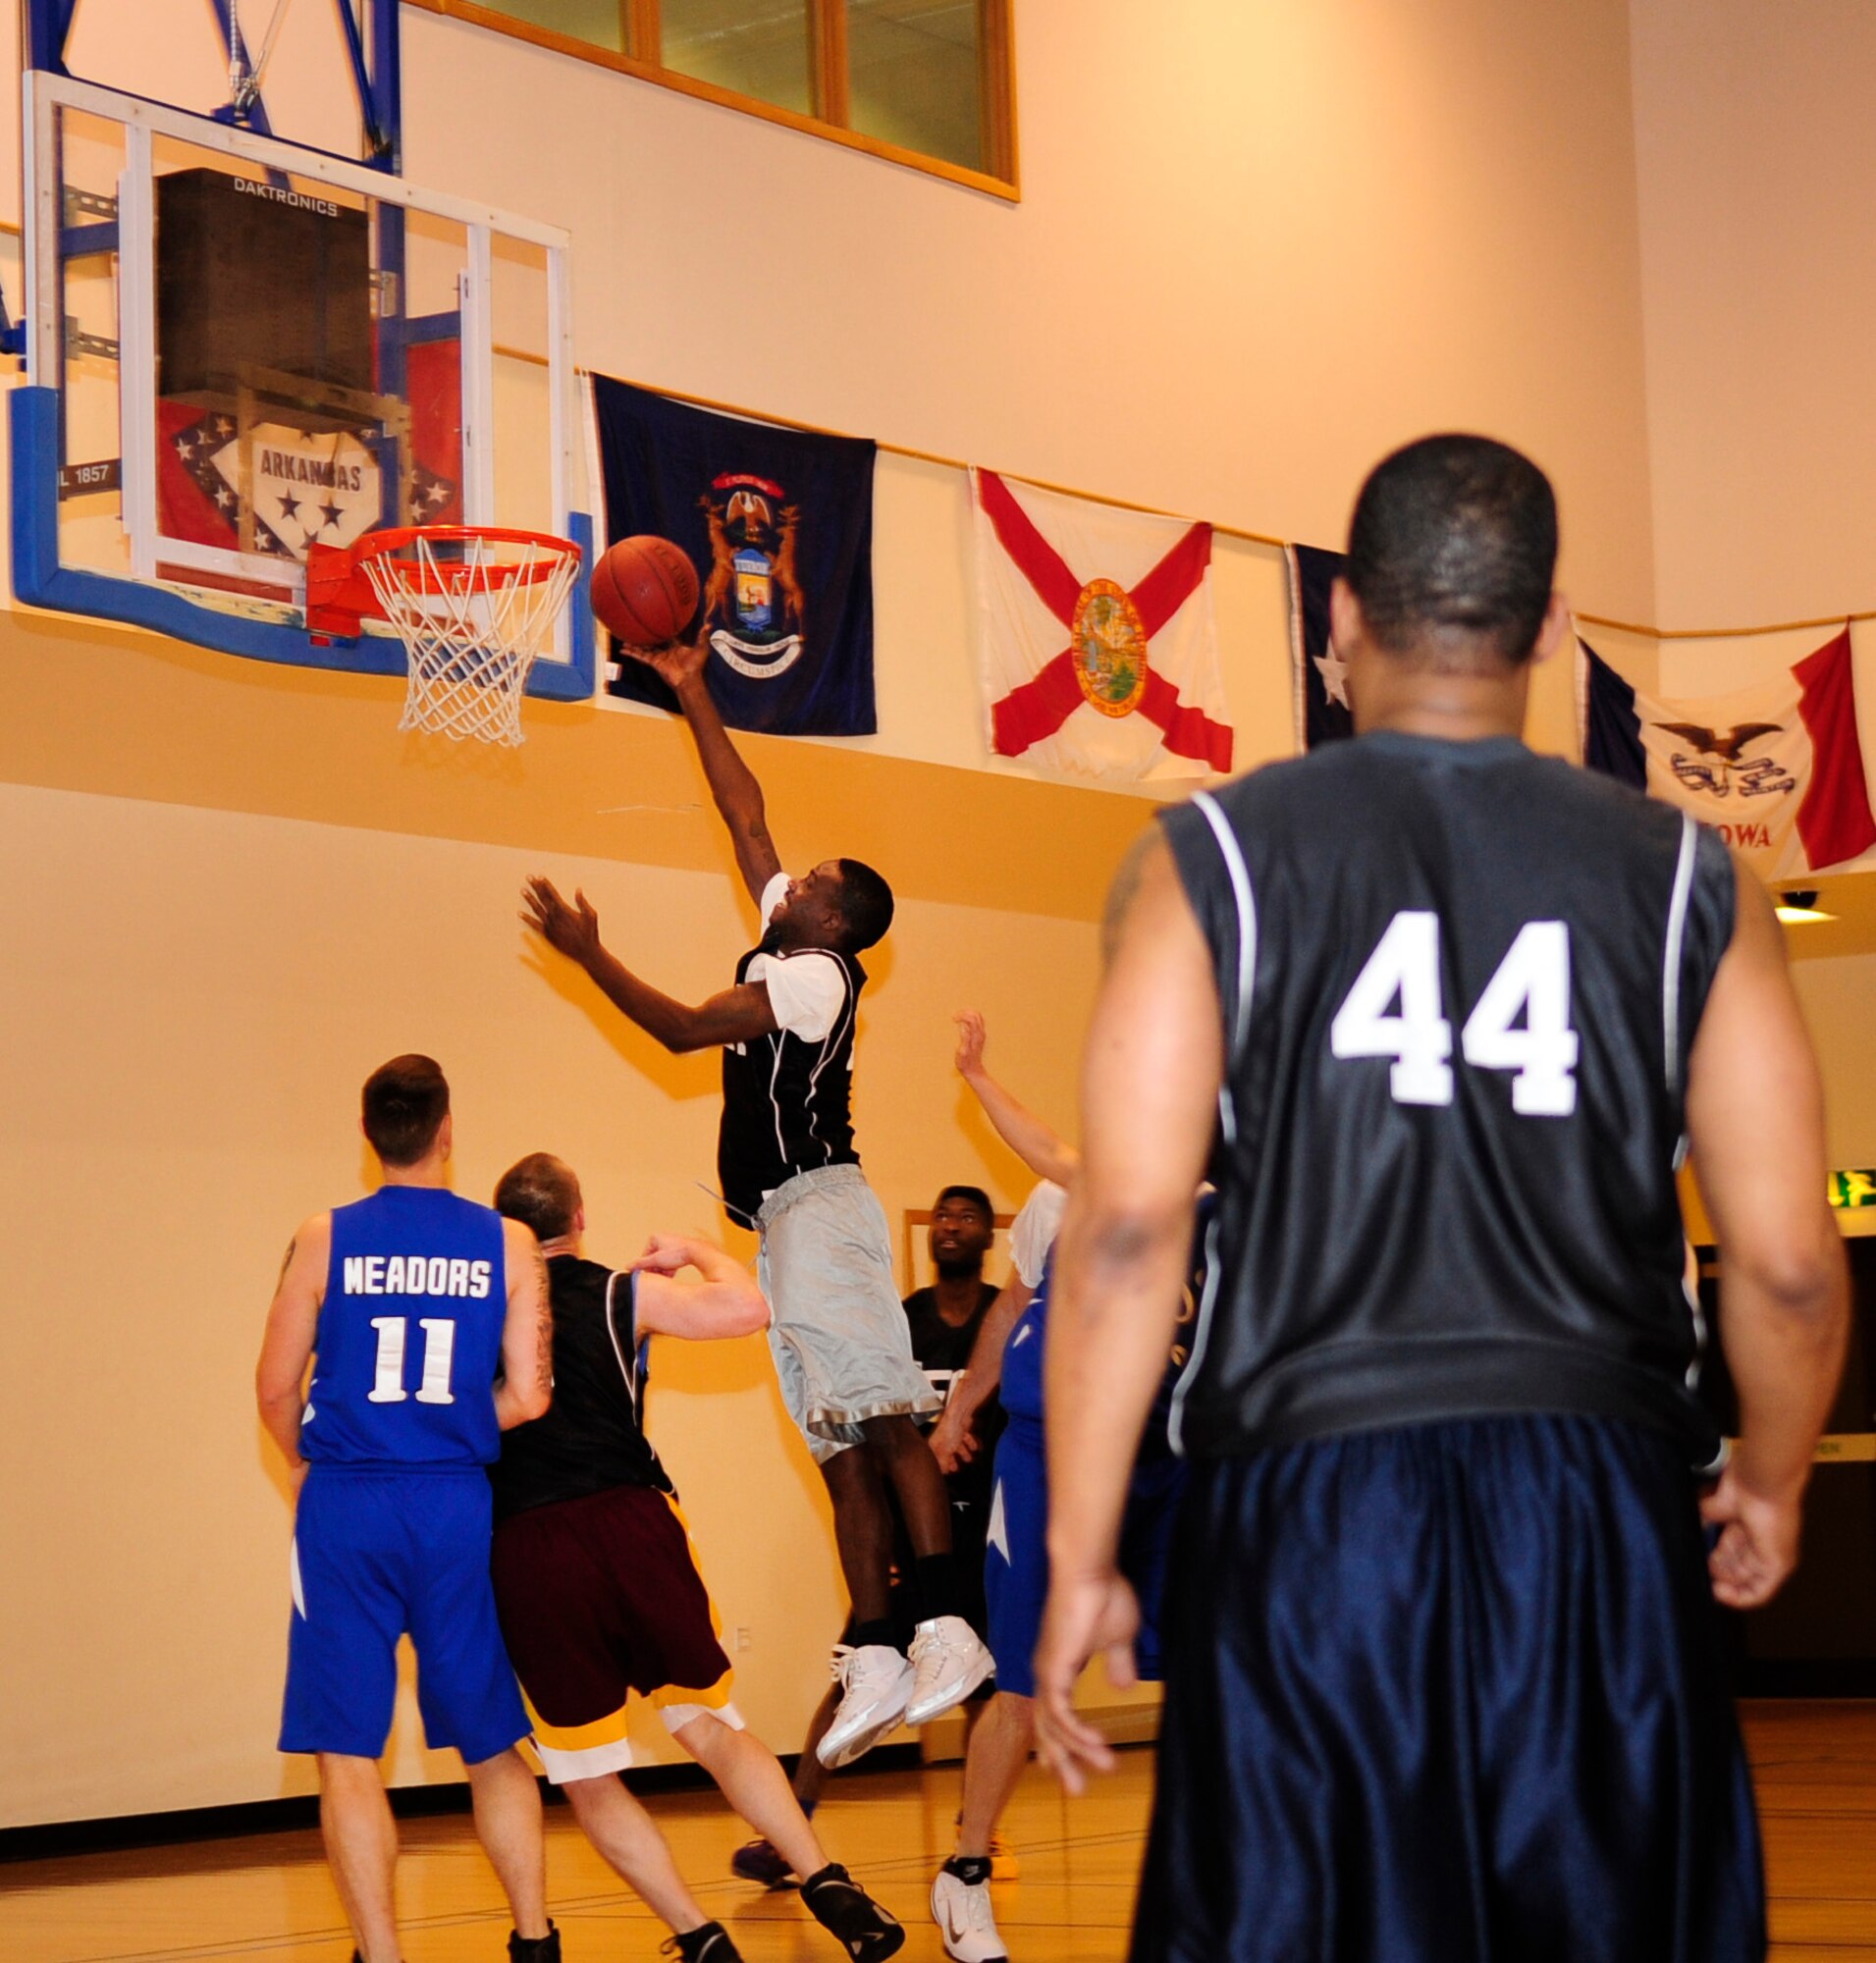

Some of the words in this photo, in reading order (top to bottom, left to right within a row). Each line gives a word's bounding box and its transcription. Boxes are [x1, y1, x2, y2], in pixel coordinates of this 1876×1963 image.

[234, 177, 338, 218] DAKTRONICS
[76, 464, 109, 484] 1857
[260, 450, 361, 492] ARKANAS
[1715, 822, 1771, 848] OWA
[1330, 909, 1580, 1117] 44
[344, 1255, 491, 1299] MEADORS
[367, 1316, 456, 1405] 11
